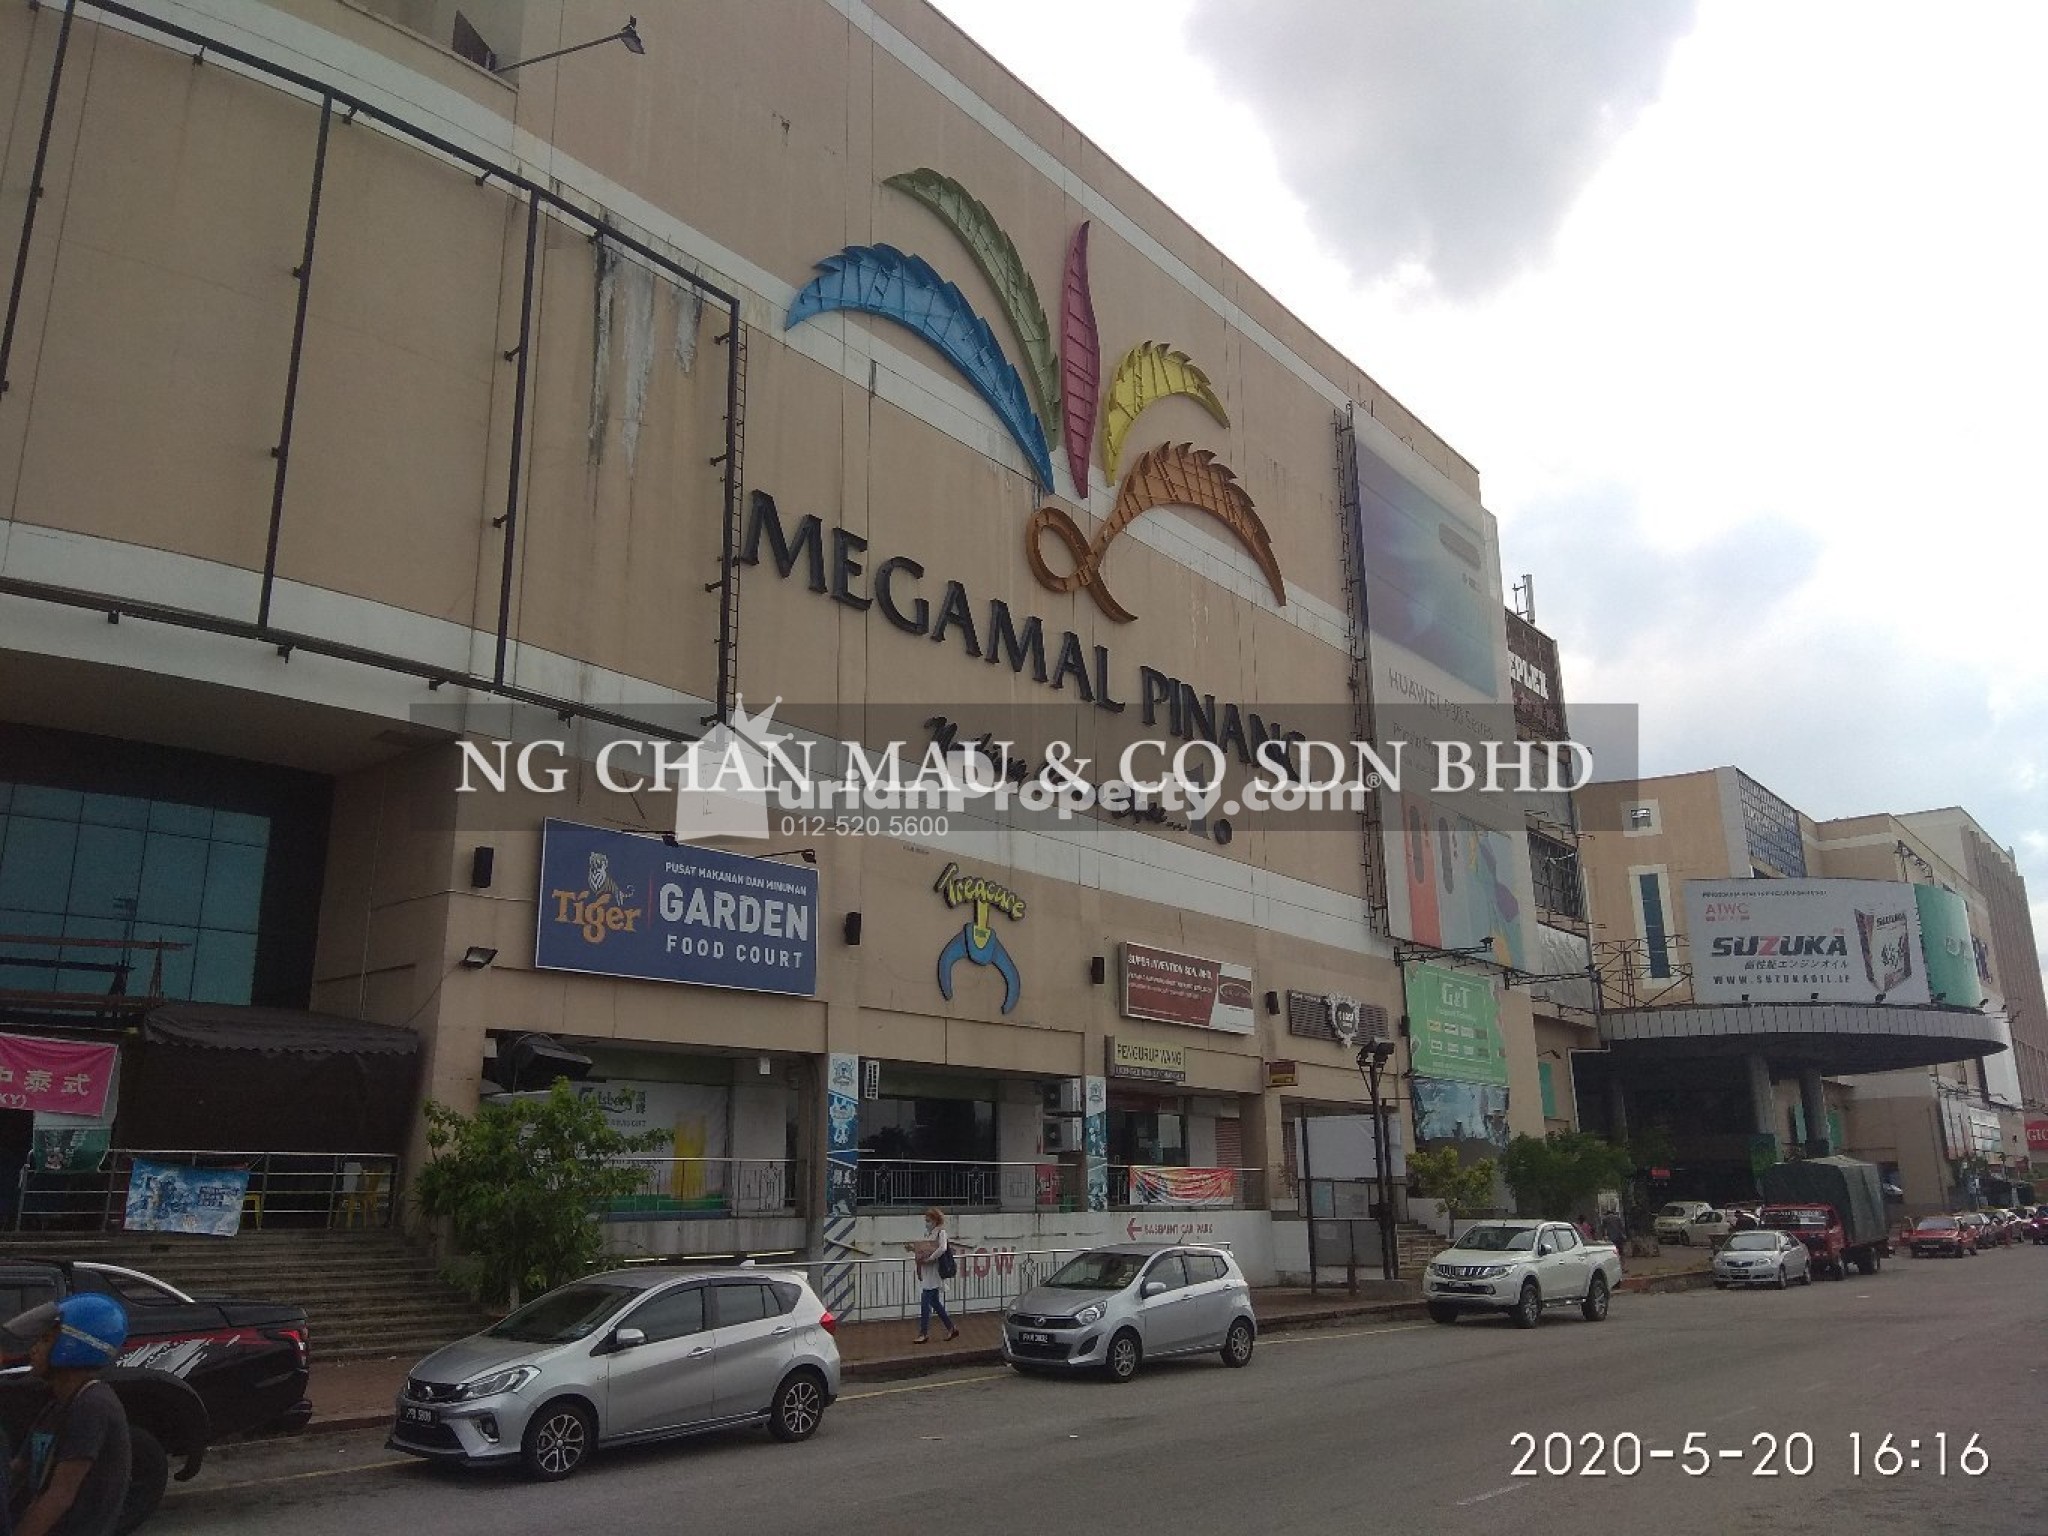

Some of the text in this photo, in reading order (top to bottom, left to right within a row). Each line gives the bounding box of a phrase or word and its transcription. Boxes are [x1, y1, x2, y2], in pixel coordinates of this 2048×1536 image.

[738, 489, 1126, 714] MEGAMAL
[1388, 667, 1441, 712] HUAWEI
[665, 861, 807, 896] PUSAT MAKANAN DAN MINUMAN
[552, 888, 642, 943] Tiger
[659, 883, 808, 941] GARDEN
[666, 934, 803, 969] FOOD COURT
[1128, 953, 1150, 967] SUPER
[1150, 959, 1183, 974] INVENTION
[1711, 935, 1848, 957] SUZUKA
[1144, 1223, 1214, 1235] BASEMENT CAR PARK
